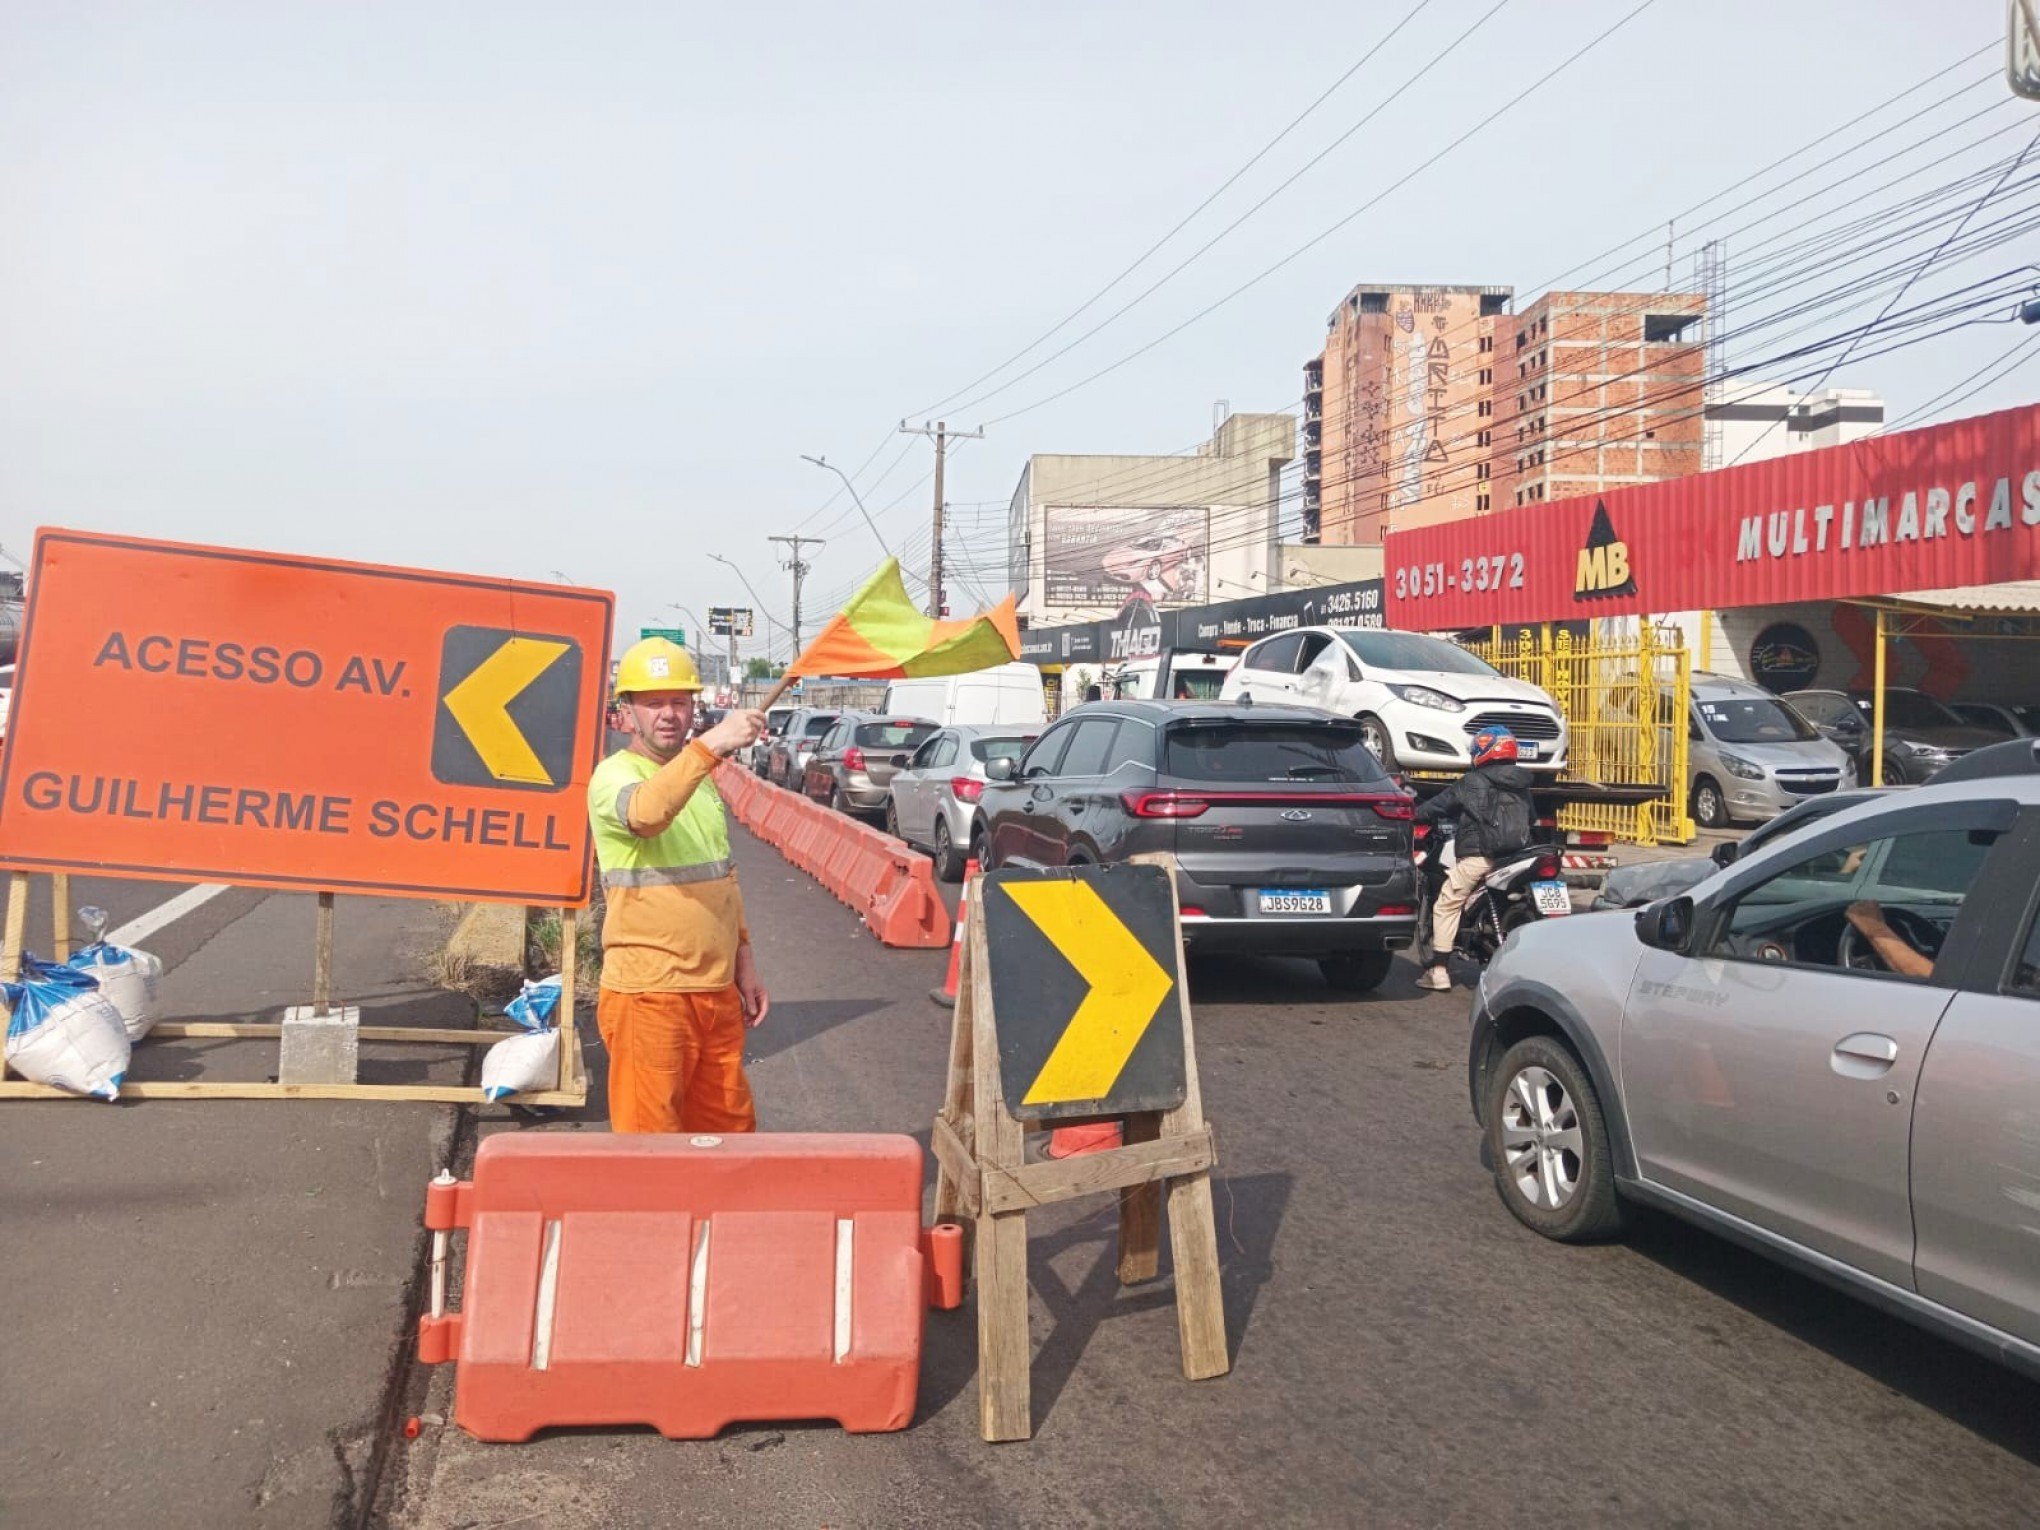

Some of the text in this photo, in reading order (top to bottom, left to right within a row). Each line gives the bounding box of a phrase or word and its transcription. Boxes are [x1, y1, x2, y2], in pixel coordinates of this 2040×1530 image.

[1736, 470, 2040, 562] MULTIMARCAS
[1395, 552, 1524, 599] 3051-3372
[1575, 541, 1630, 592] MB
[1247, 617, 1265, 633] Troca
[1328, 589, 1378, 614] 3426.5160
[94, 631, 411, 698] ACESSO AV.
[22, 771, 570, 850] GUILHERME SCHELL
[1268, 897, 1324, 911] JBS9G28
